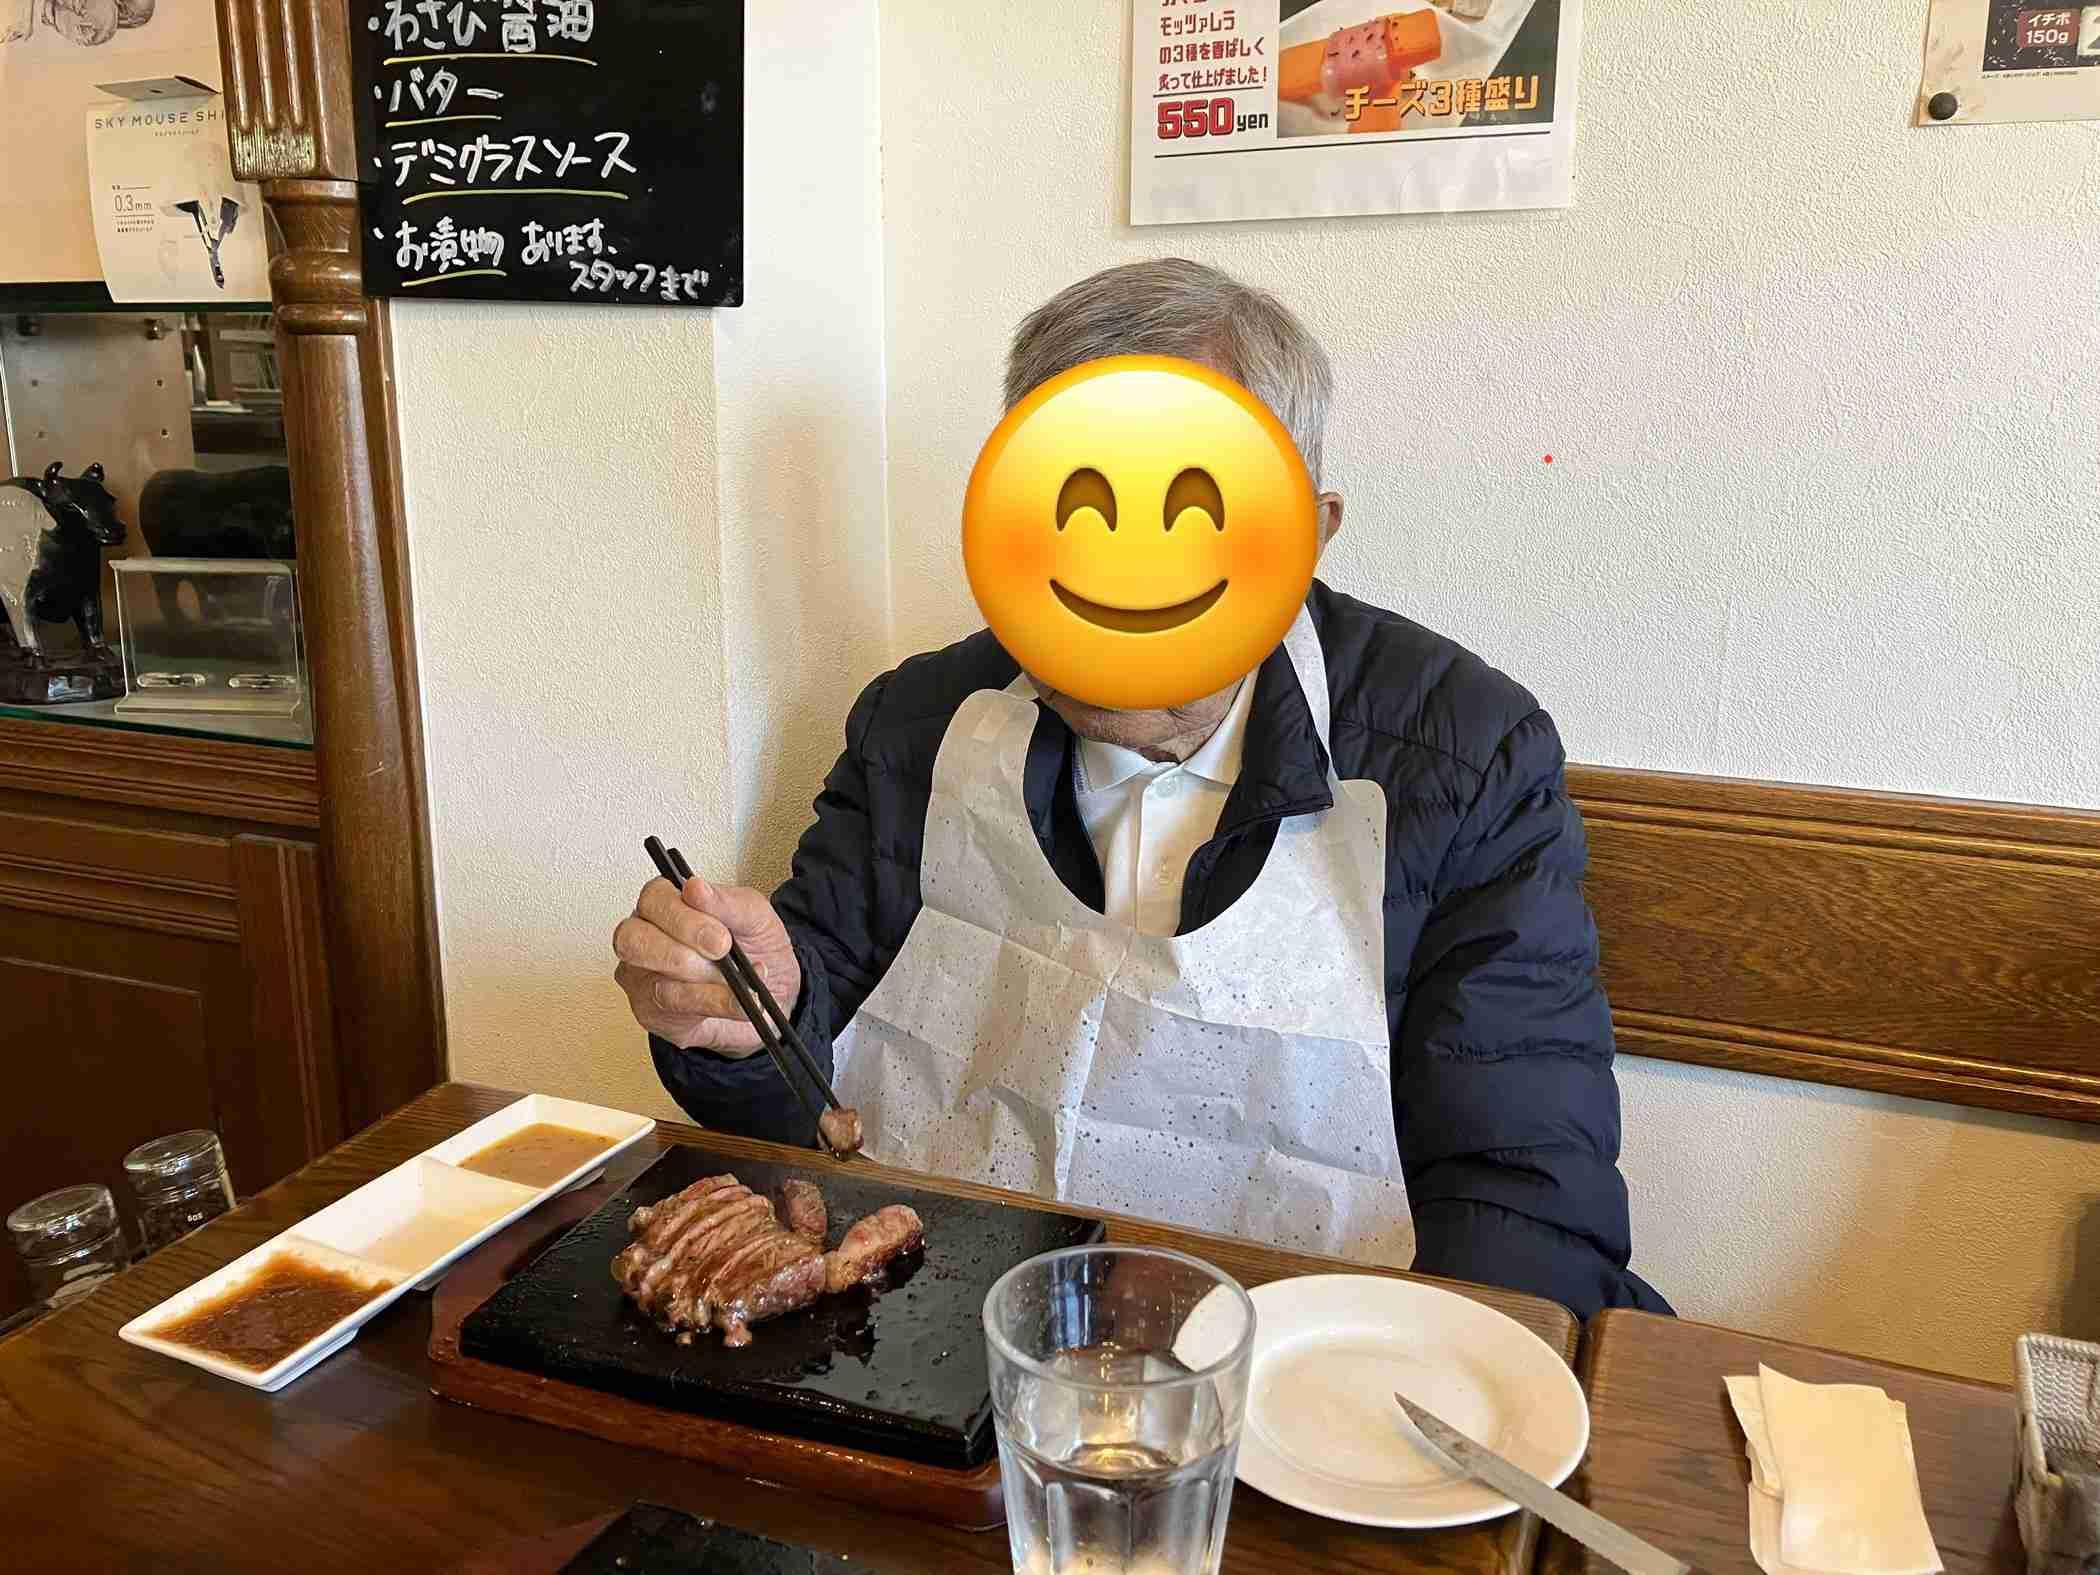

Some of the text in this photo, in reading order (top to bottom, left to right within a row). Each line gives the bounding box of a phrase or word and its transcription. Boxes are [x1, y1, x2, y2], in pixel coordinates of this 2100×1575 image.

[1160, 10, 1235, 36] モッツァレラ
[2026, 29, 2069, 44] 150g
[1160, 37, 1265, 64] の3種を香ばしく
[389, 67, 504, 115] バター
[1344, 75, 1540, 123] チーズ3種盛り
[95, 117, 125, 129] SKY
[131, 112, 189, 127] MOUSE
[391, 132, 637, 186] デミグラスソース
[569, 258, 709, 301] スタッフまで
